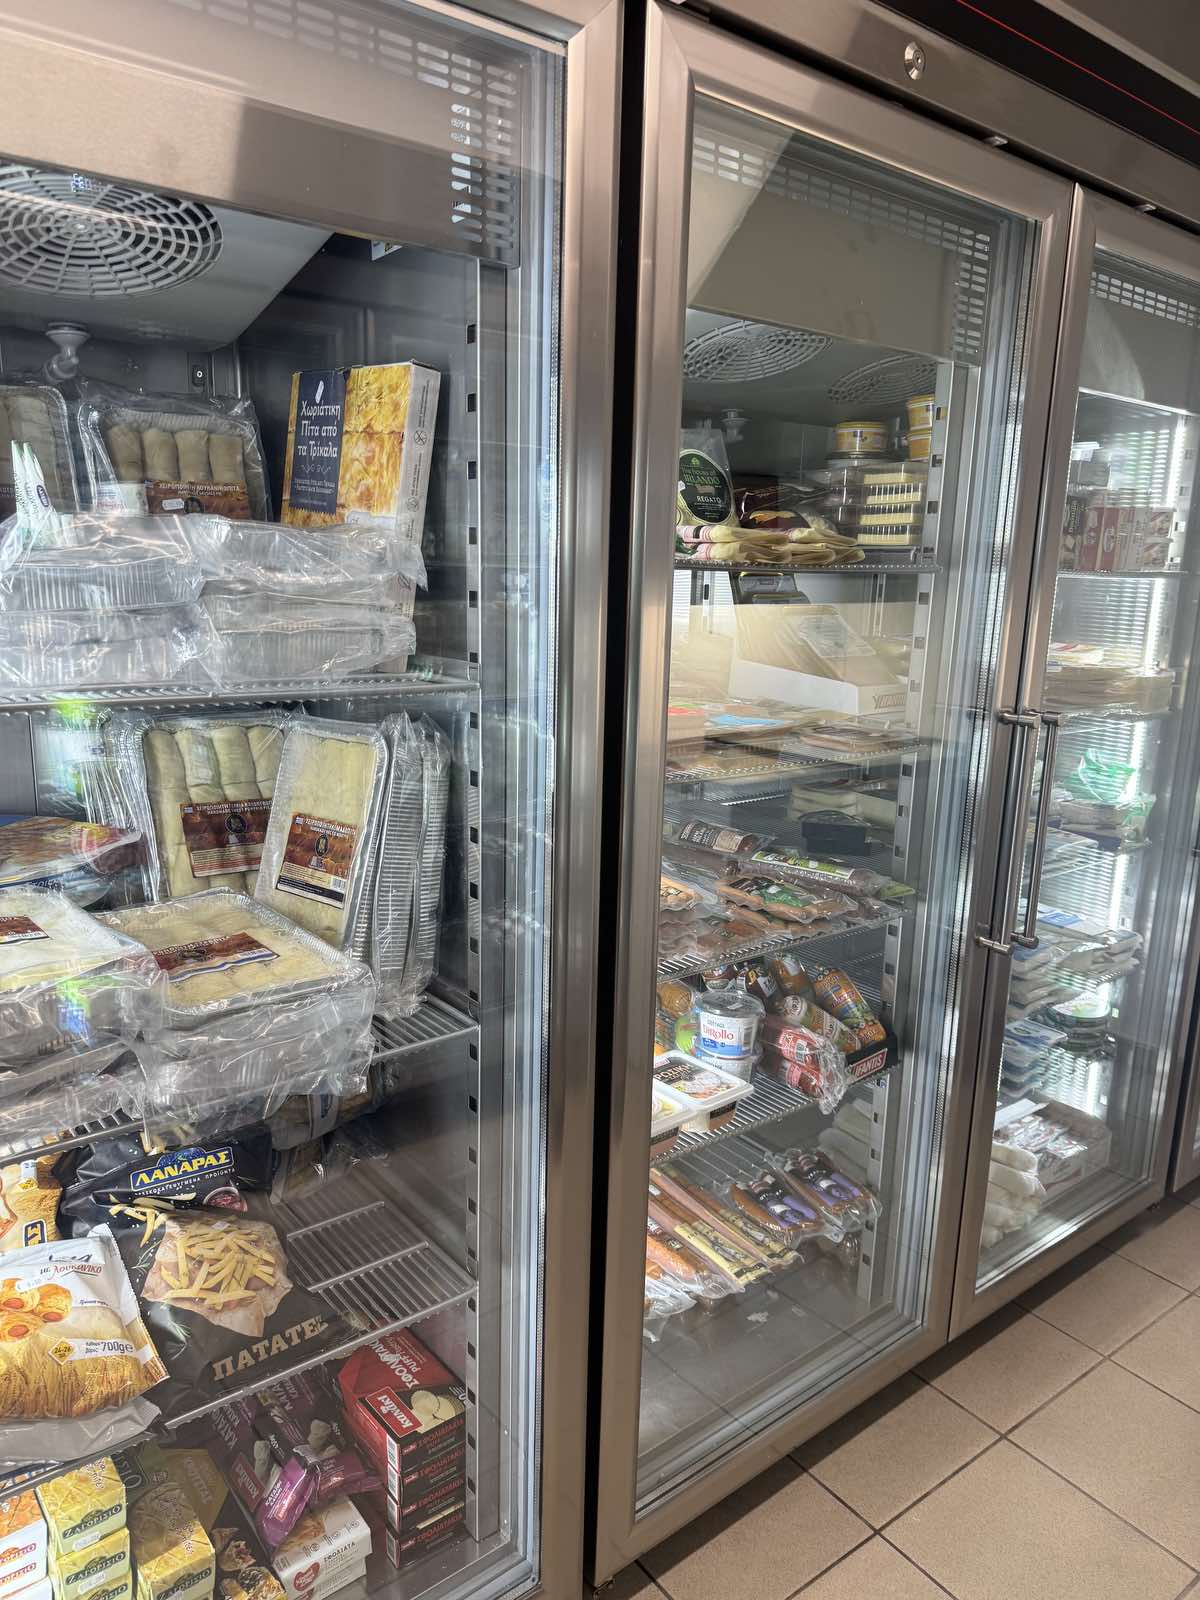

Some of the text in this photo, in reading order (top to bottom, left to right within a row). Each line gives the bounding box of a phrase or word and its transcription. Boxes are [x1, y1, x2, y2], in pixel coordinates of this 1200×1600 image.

[300, 400, 341, 420] Χωριάτικη
[301, 420, 338, 438] Πίτα από
[297, 440, 338, 460] τα Τρίκαλα
[135, 1150, 231, 1187] ΛΑΝΑΡΑΣ
